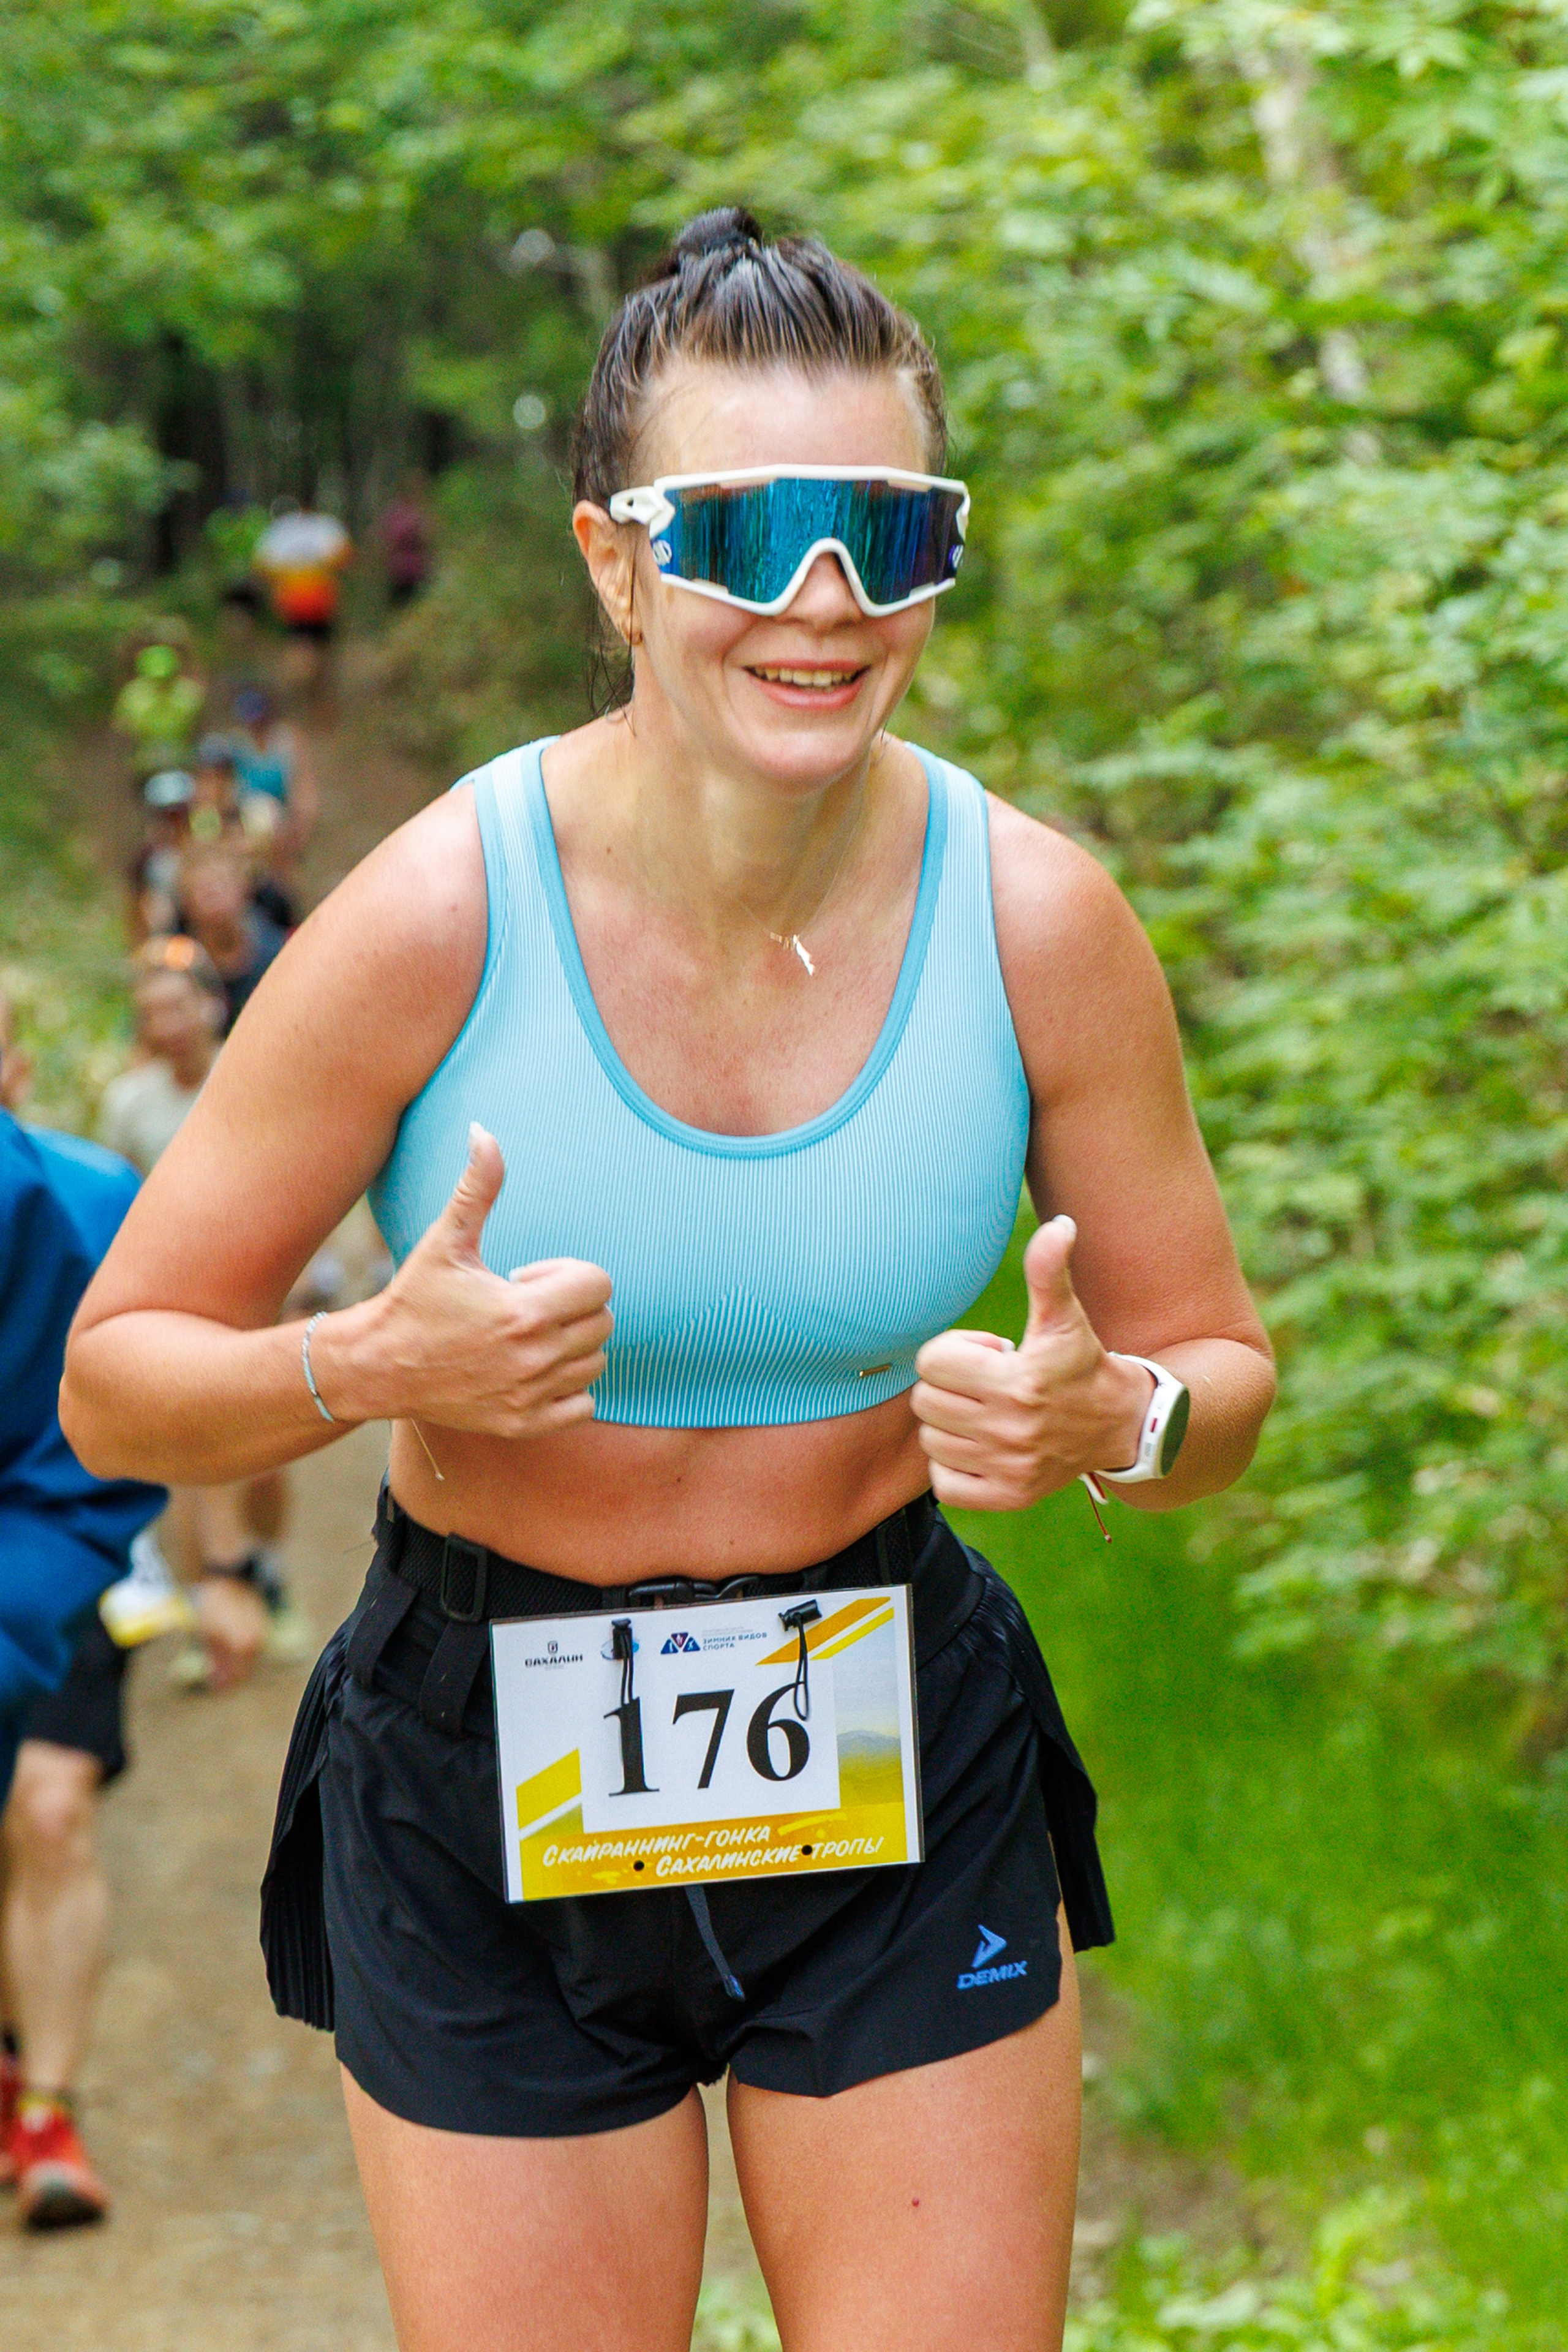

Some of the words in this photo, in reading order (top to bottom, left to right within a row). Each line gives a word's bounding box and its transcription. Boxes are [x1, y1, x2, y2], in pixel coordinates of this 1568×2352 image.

[703, 1642, 735, 1651] СПОРТА
[738, 1632, 767, 1641] ВИДОВ
[604, 1681, 810, 1796] 176
[811, 1836, 884, 1860] ТРОПЫ
[956, 1960, 1028, 1989] DEMIX
